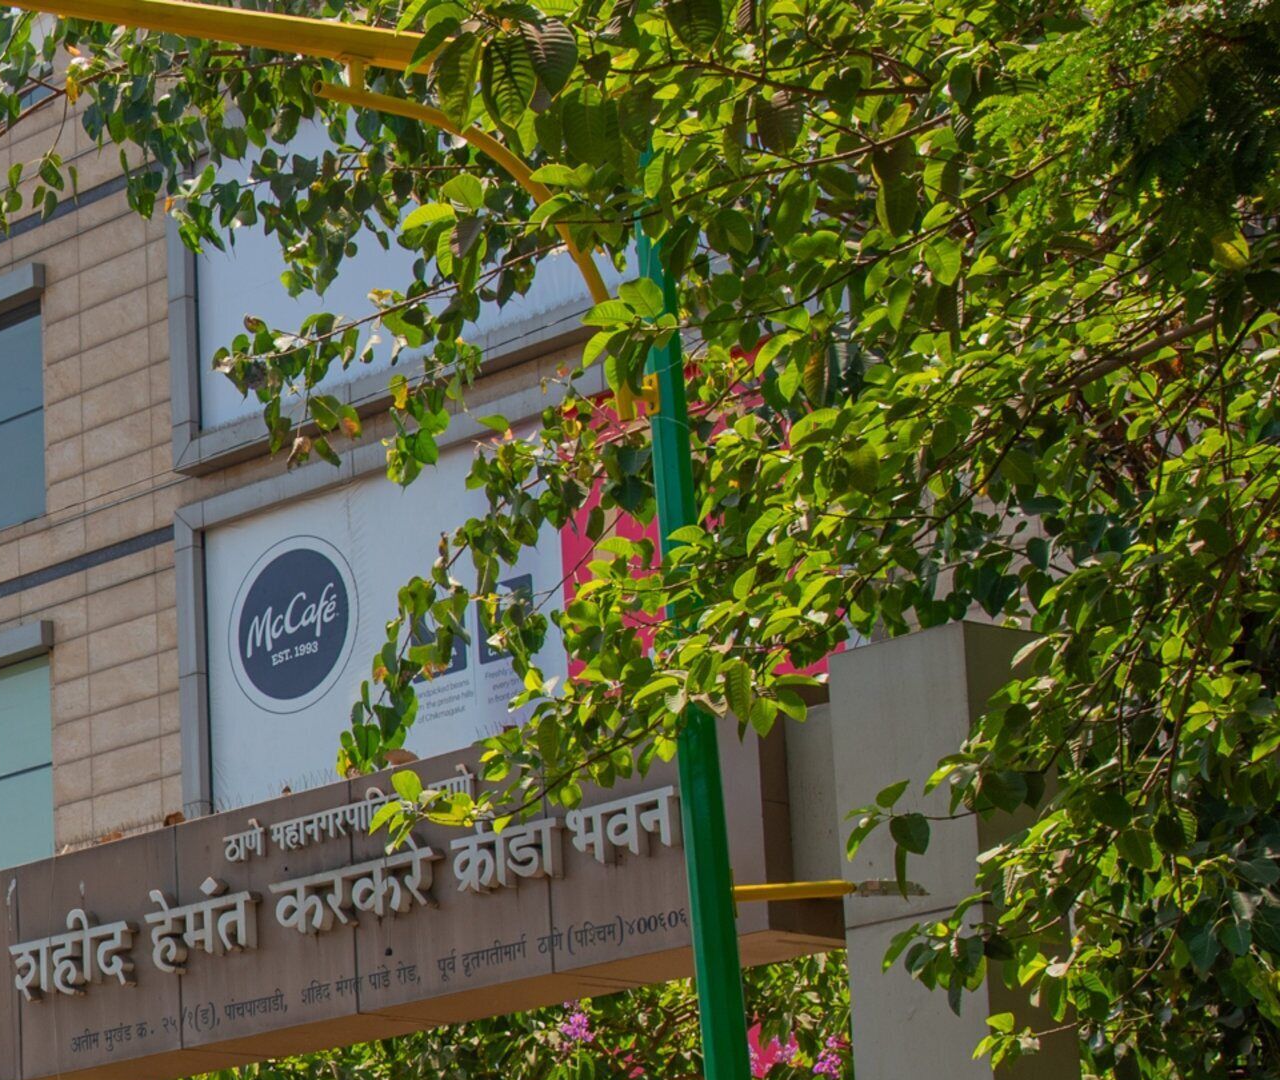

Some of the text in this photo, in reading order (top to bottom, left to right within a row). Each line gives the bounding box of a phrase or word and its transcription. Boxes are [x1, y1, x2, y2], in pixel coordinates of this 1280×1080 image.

[246, 582, 338, 659] McCafé
[271, 641, 319, 666] EST. 1993
[222, 817, 264, 862] ठाणे
[8, 908, 130, 1001] शहीद
[144, 876, 253, 973] हेमंत
[268, 832, 436, 936] करकरे
[565, 785, 677, 864] भवन
